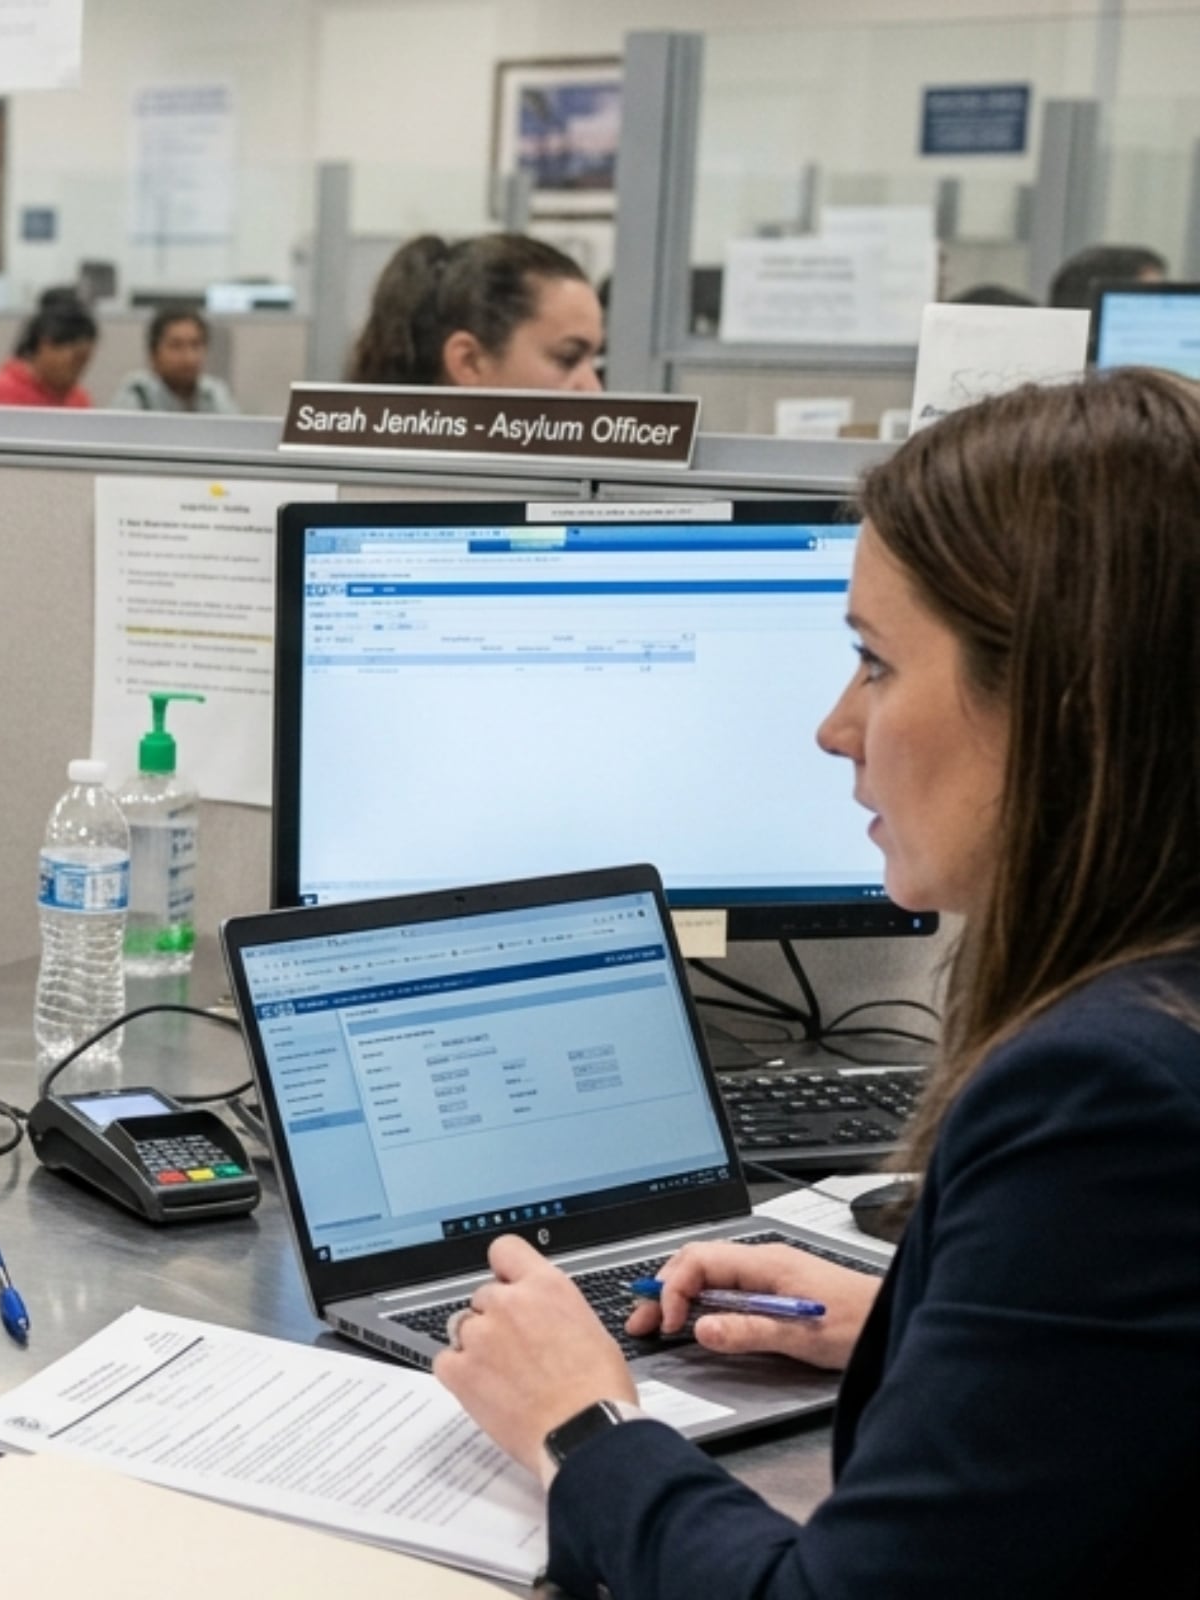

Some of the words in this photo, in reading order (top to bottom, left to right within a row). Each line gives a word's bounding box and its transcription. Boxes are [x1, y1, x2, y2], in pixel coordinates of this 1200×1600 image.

[296, 405, 367, 433] Sarah
[373, 408, 468, 437] Jenkins
[489, 412, 584, 446] Asylum
[591, 415, 681, 445] Officer
